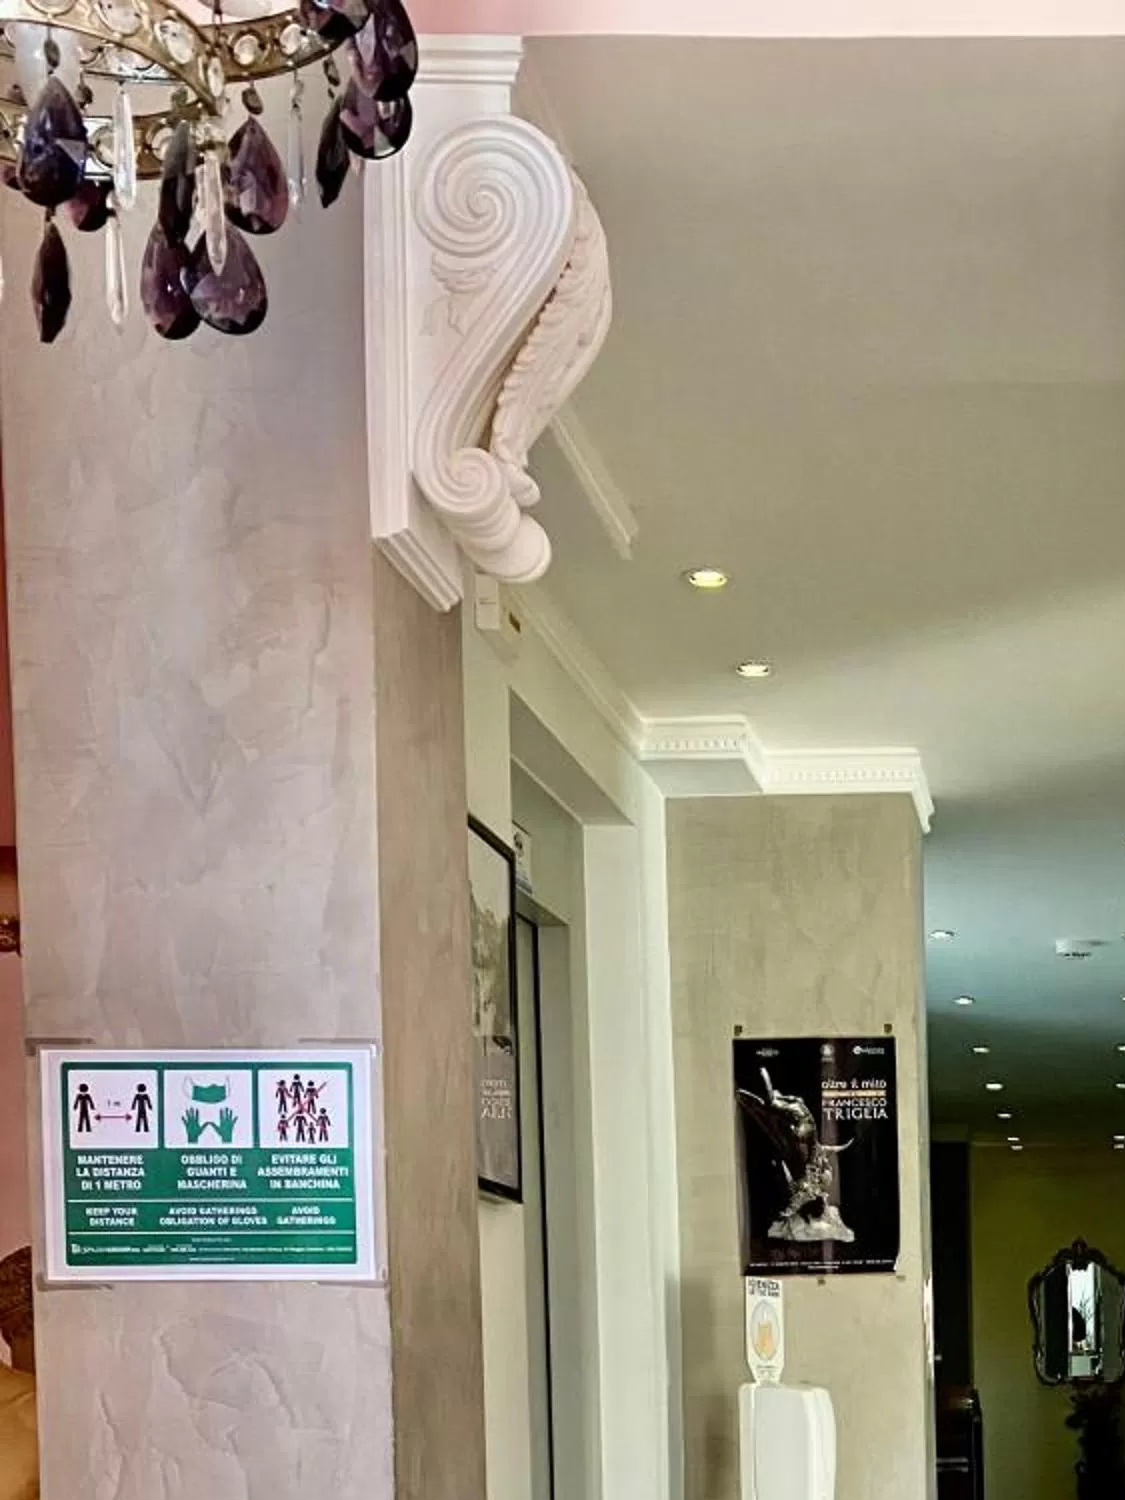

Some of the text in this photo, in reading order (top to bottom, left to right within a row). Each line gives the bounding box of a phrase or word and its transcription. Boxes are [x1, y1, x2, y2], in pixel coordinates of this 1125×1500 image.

[821, 1097, 888, 1107] FRANCESCO
[822, 1107, 889, 1120] TRIGLIA
[77, 1155, 144, 1165] MANTENERE
[180, 1154, 243, 1165] OBBLIGO DI
[271, 1154, 337, 1165] EVITARE GLI
[75, 1167, 145, 1177] LA DISTANZA
[186, 1167, 238, 1177] GUANTI E
[257, 1166, 350, 1177] ASSEMBRAMENTI
[81, 1180, 142, 1191] DI 1 METRO
[177, 1179, 248, 1190] MASCHERINA
[269, 1179, 341, 1190] IN BANCHINA
[85, 1207, 138, 1216] KEEP YOUR
[89, 1218, 136, 1227] DISTANCE
